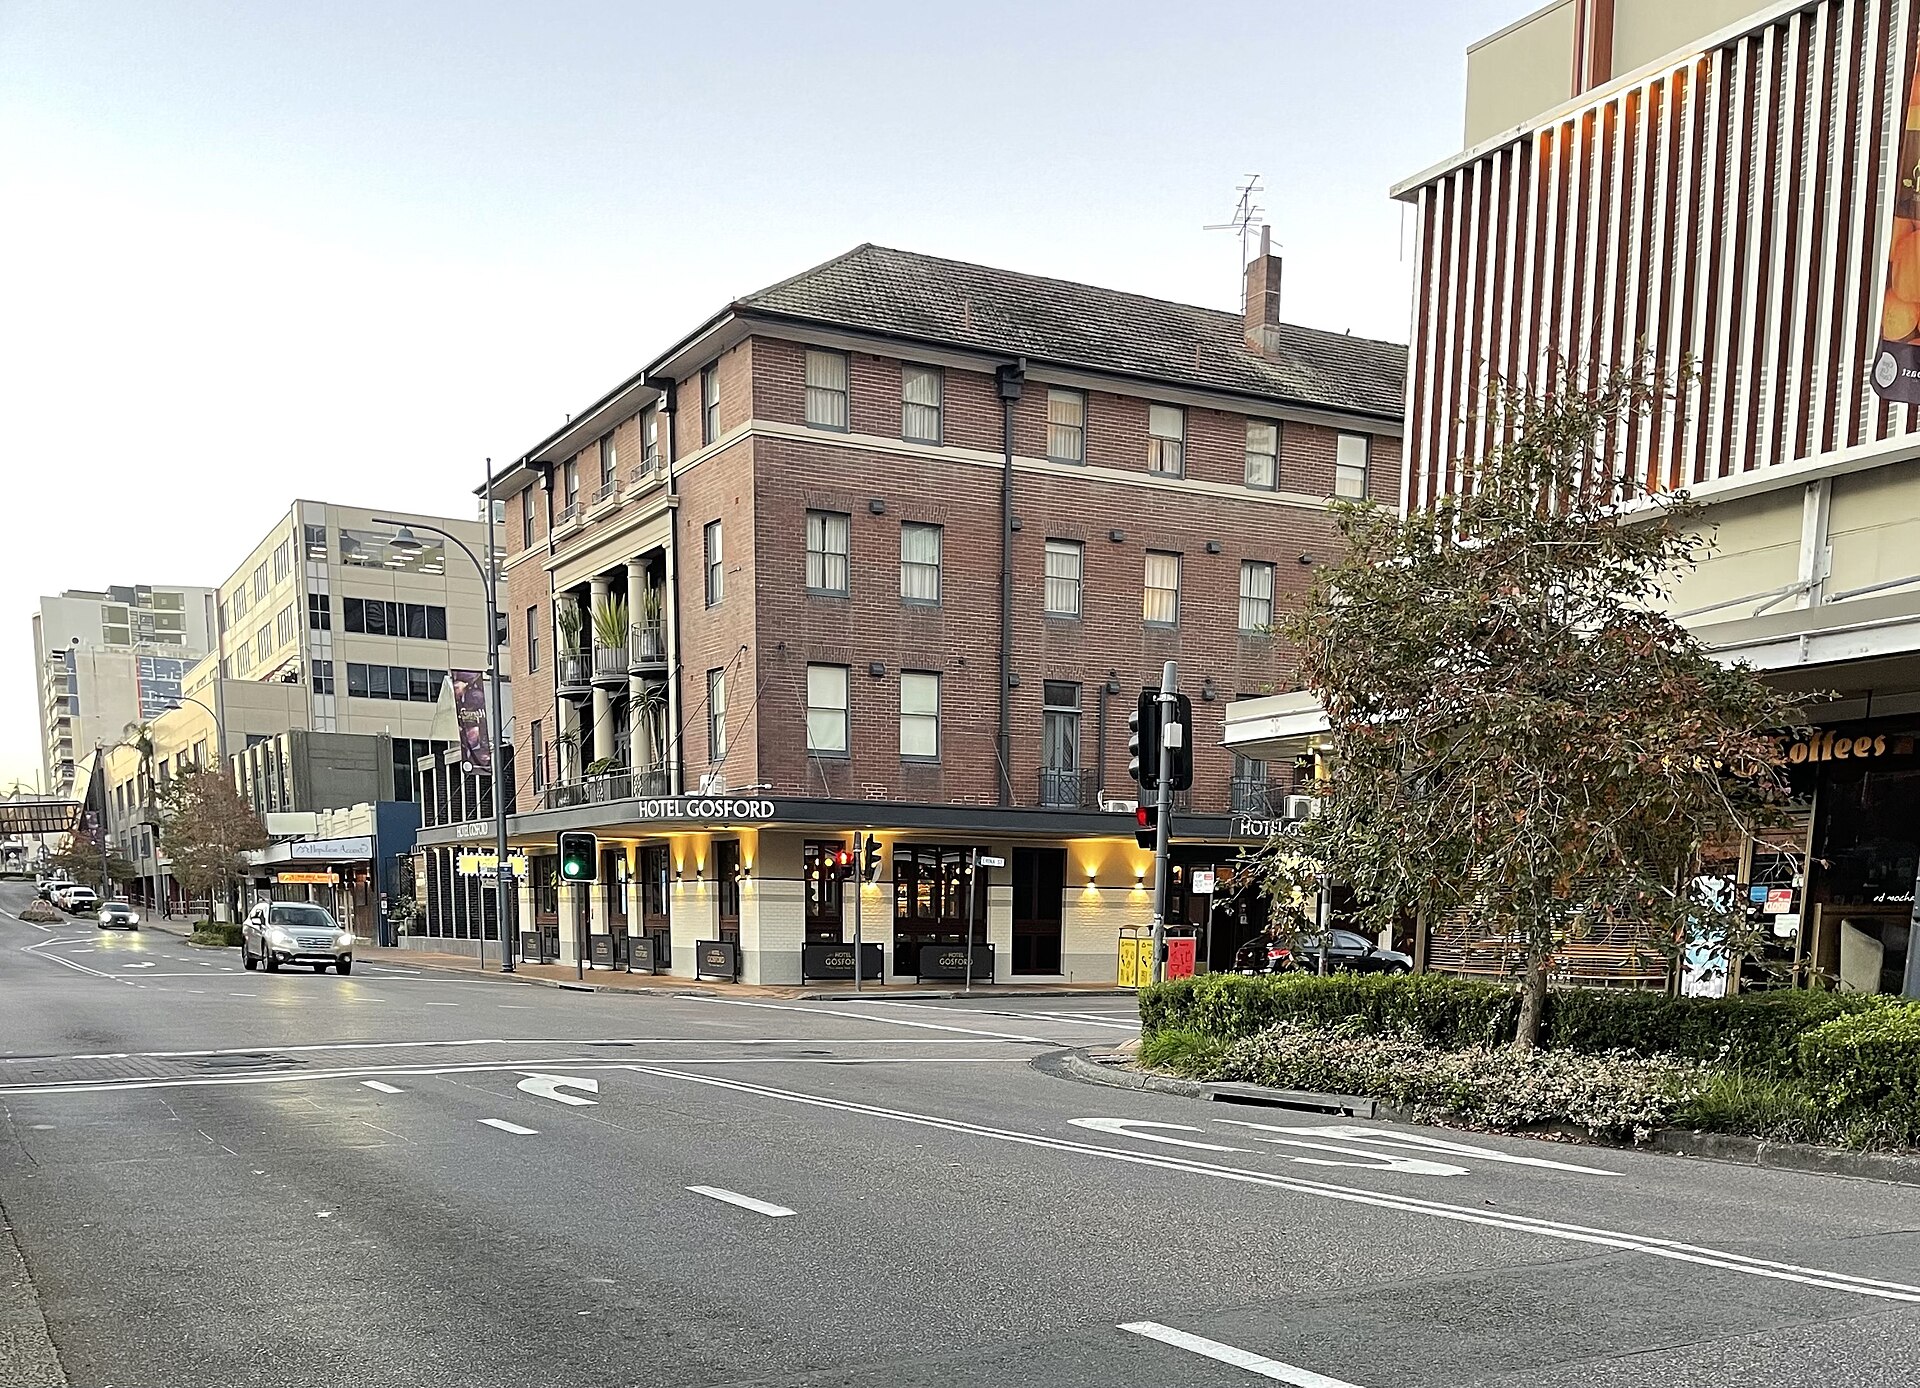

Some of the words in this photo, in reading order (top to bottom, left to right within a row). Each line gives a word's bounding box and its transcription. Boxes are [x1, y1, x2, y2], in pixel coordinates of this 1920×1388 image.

[639, 800, 683, 818] HOTEL
[686, 800, 775, 818] GOSFORD
[825, 958, 855, 966] GOSFOR
